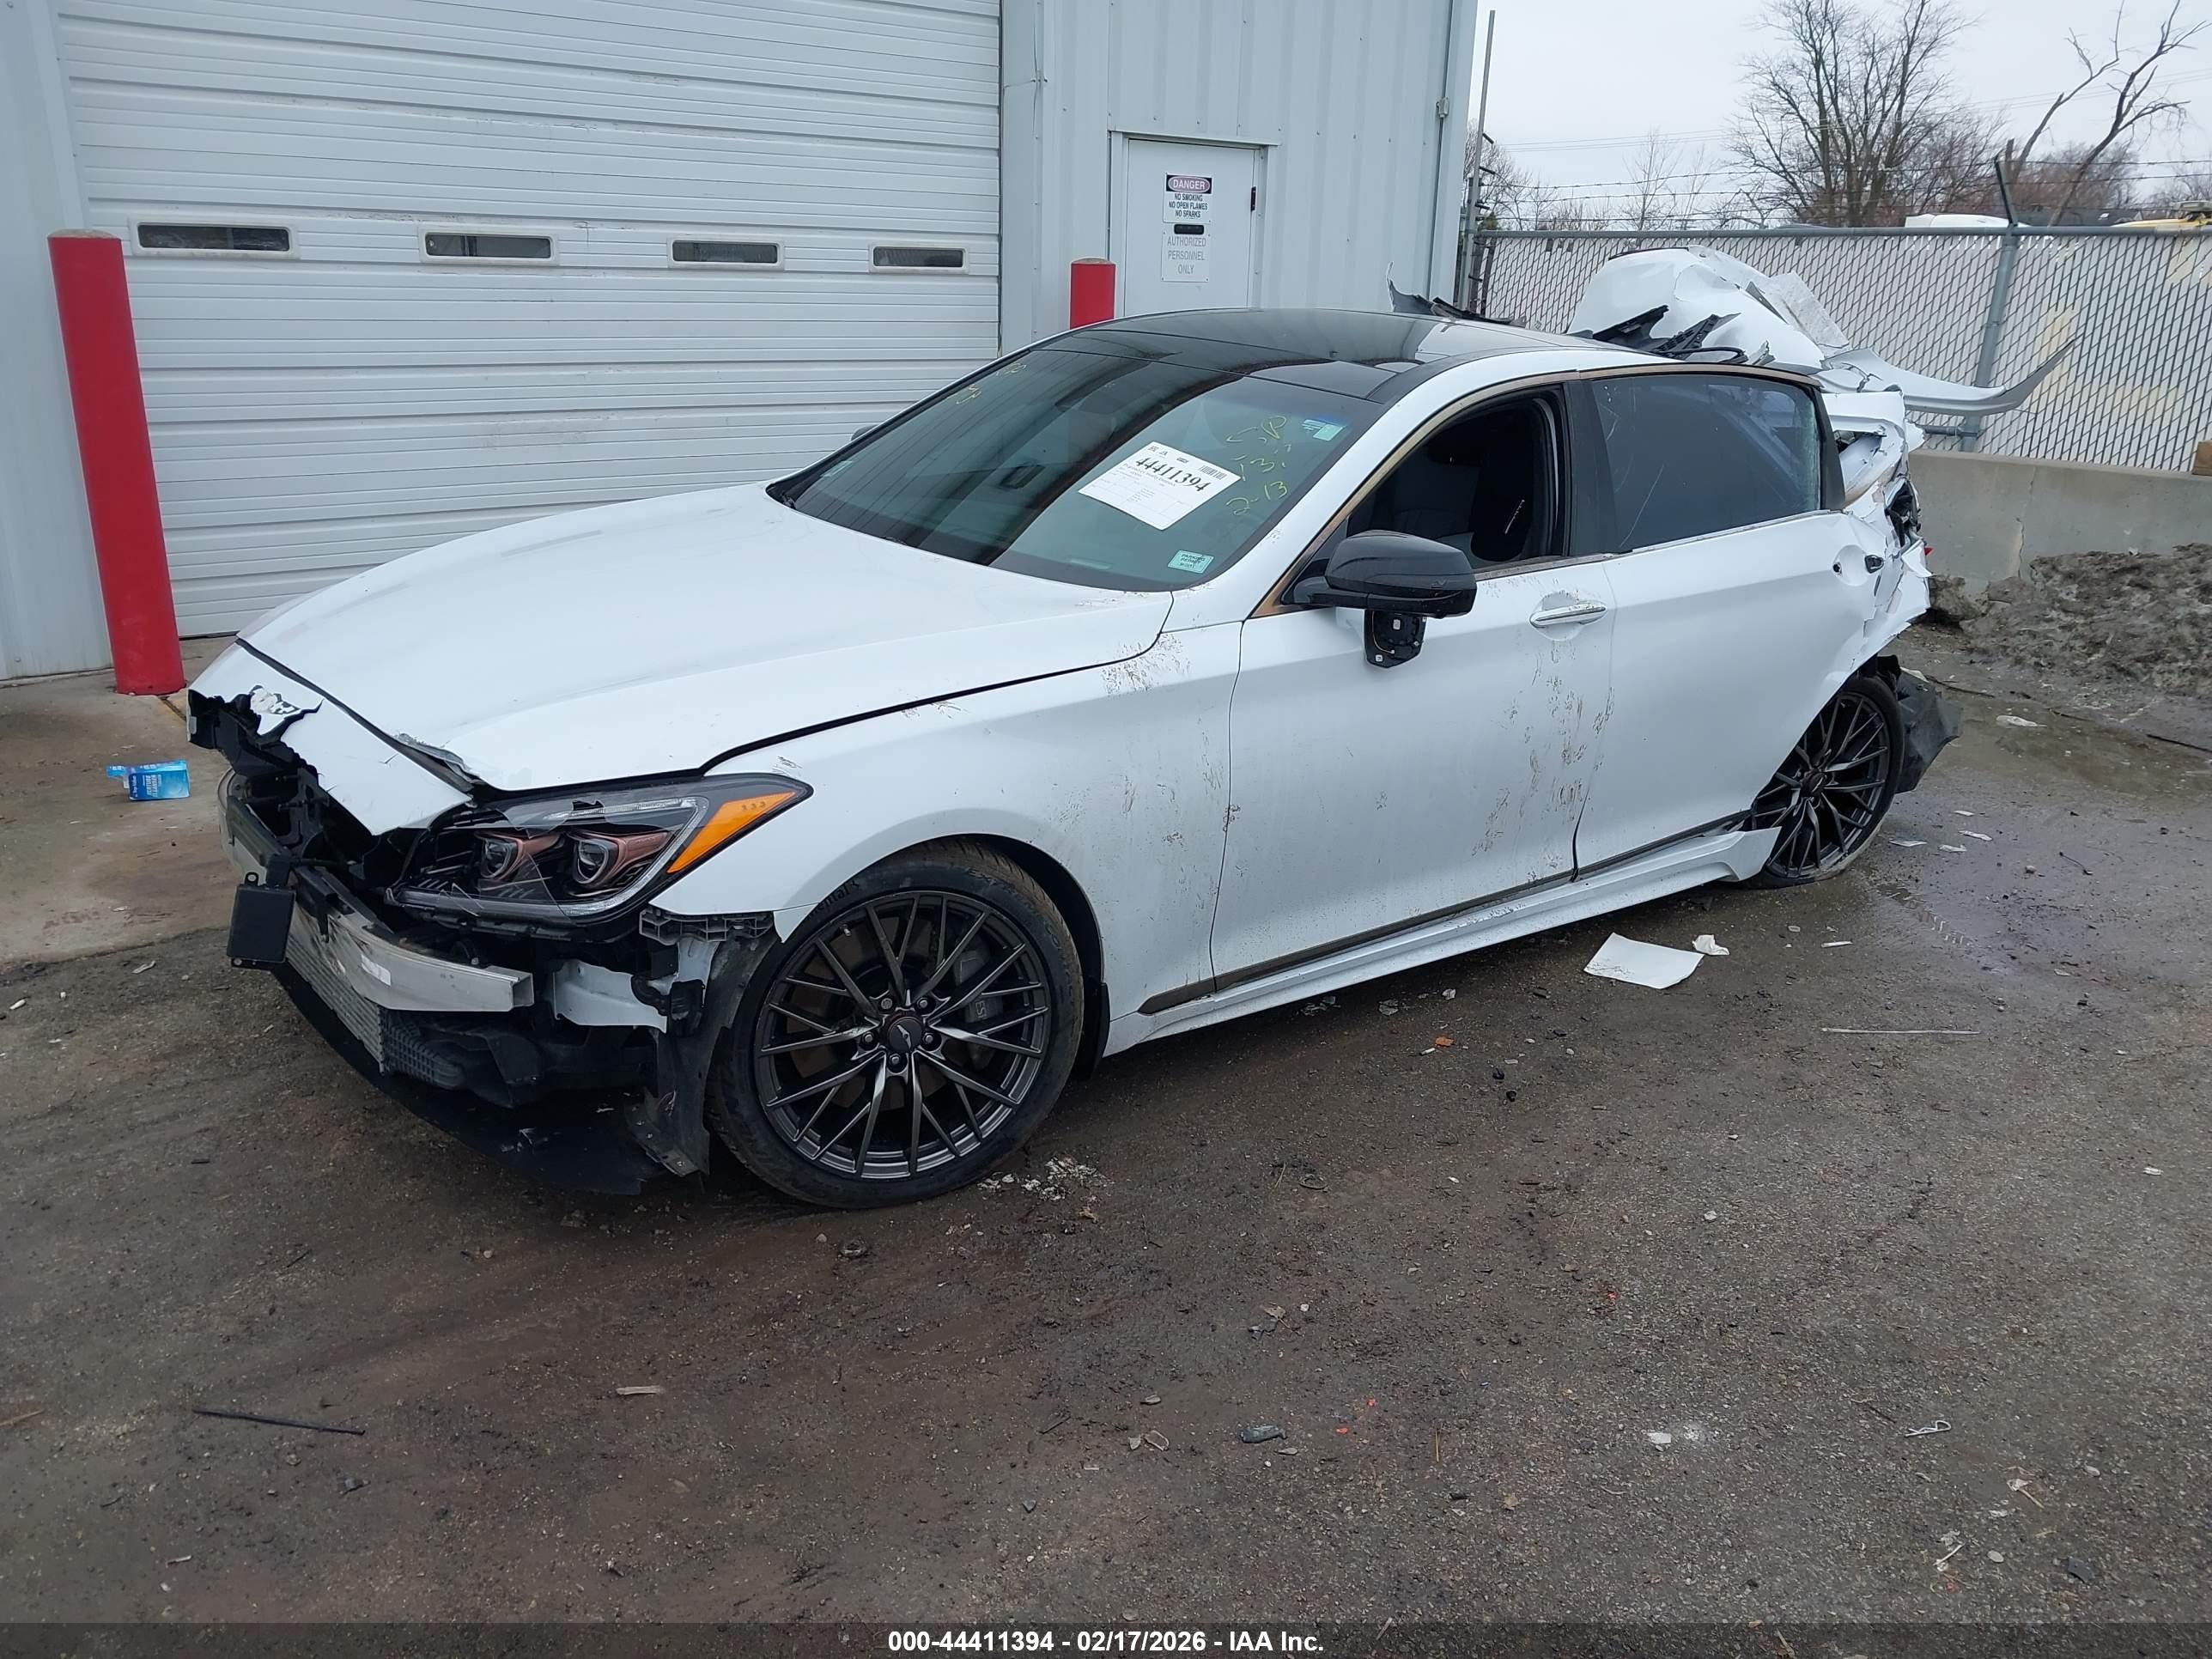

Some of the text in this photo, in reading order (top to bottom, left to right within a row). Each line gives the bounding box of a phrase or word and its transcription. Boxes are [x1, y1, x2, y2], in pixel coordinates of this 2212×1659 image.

[1173, 179, 1206, 190] DANGER
[1182, 193, 1203, 202] SMOKING
[1167, 236, 1206, 247] AUTHORIZED
[1168, 250, 1206, 261] PERSONNEL
[1177, 264, 1194, 275] ONLY
[1135, 457, 1212, 492] 44411394
